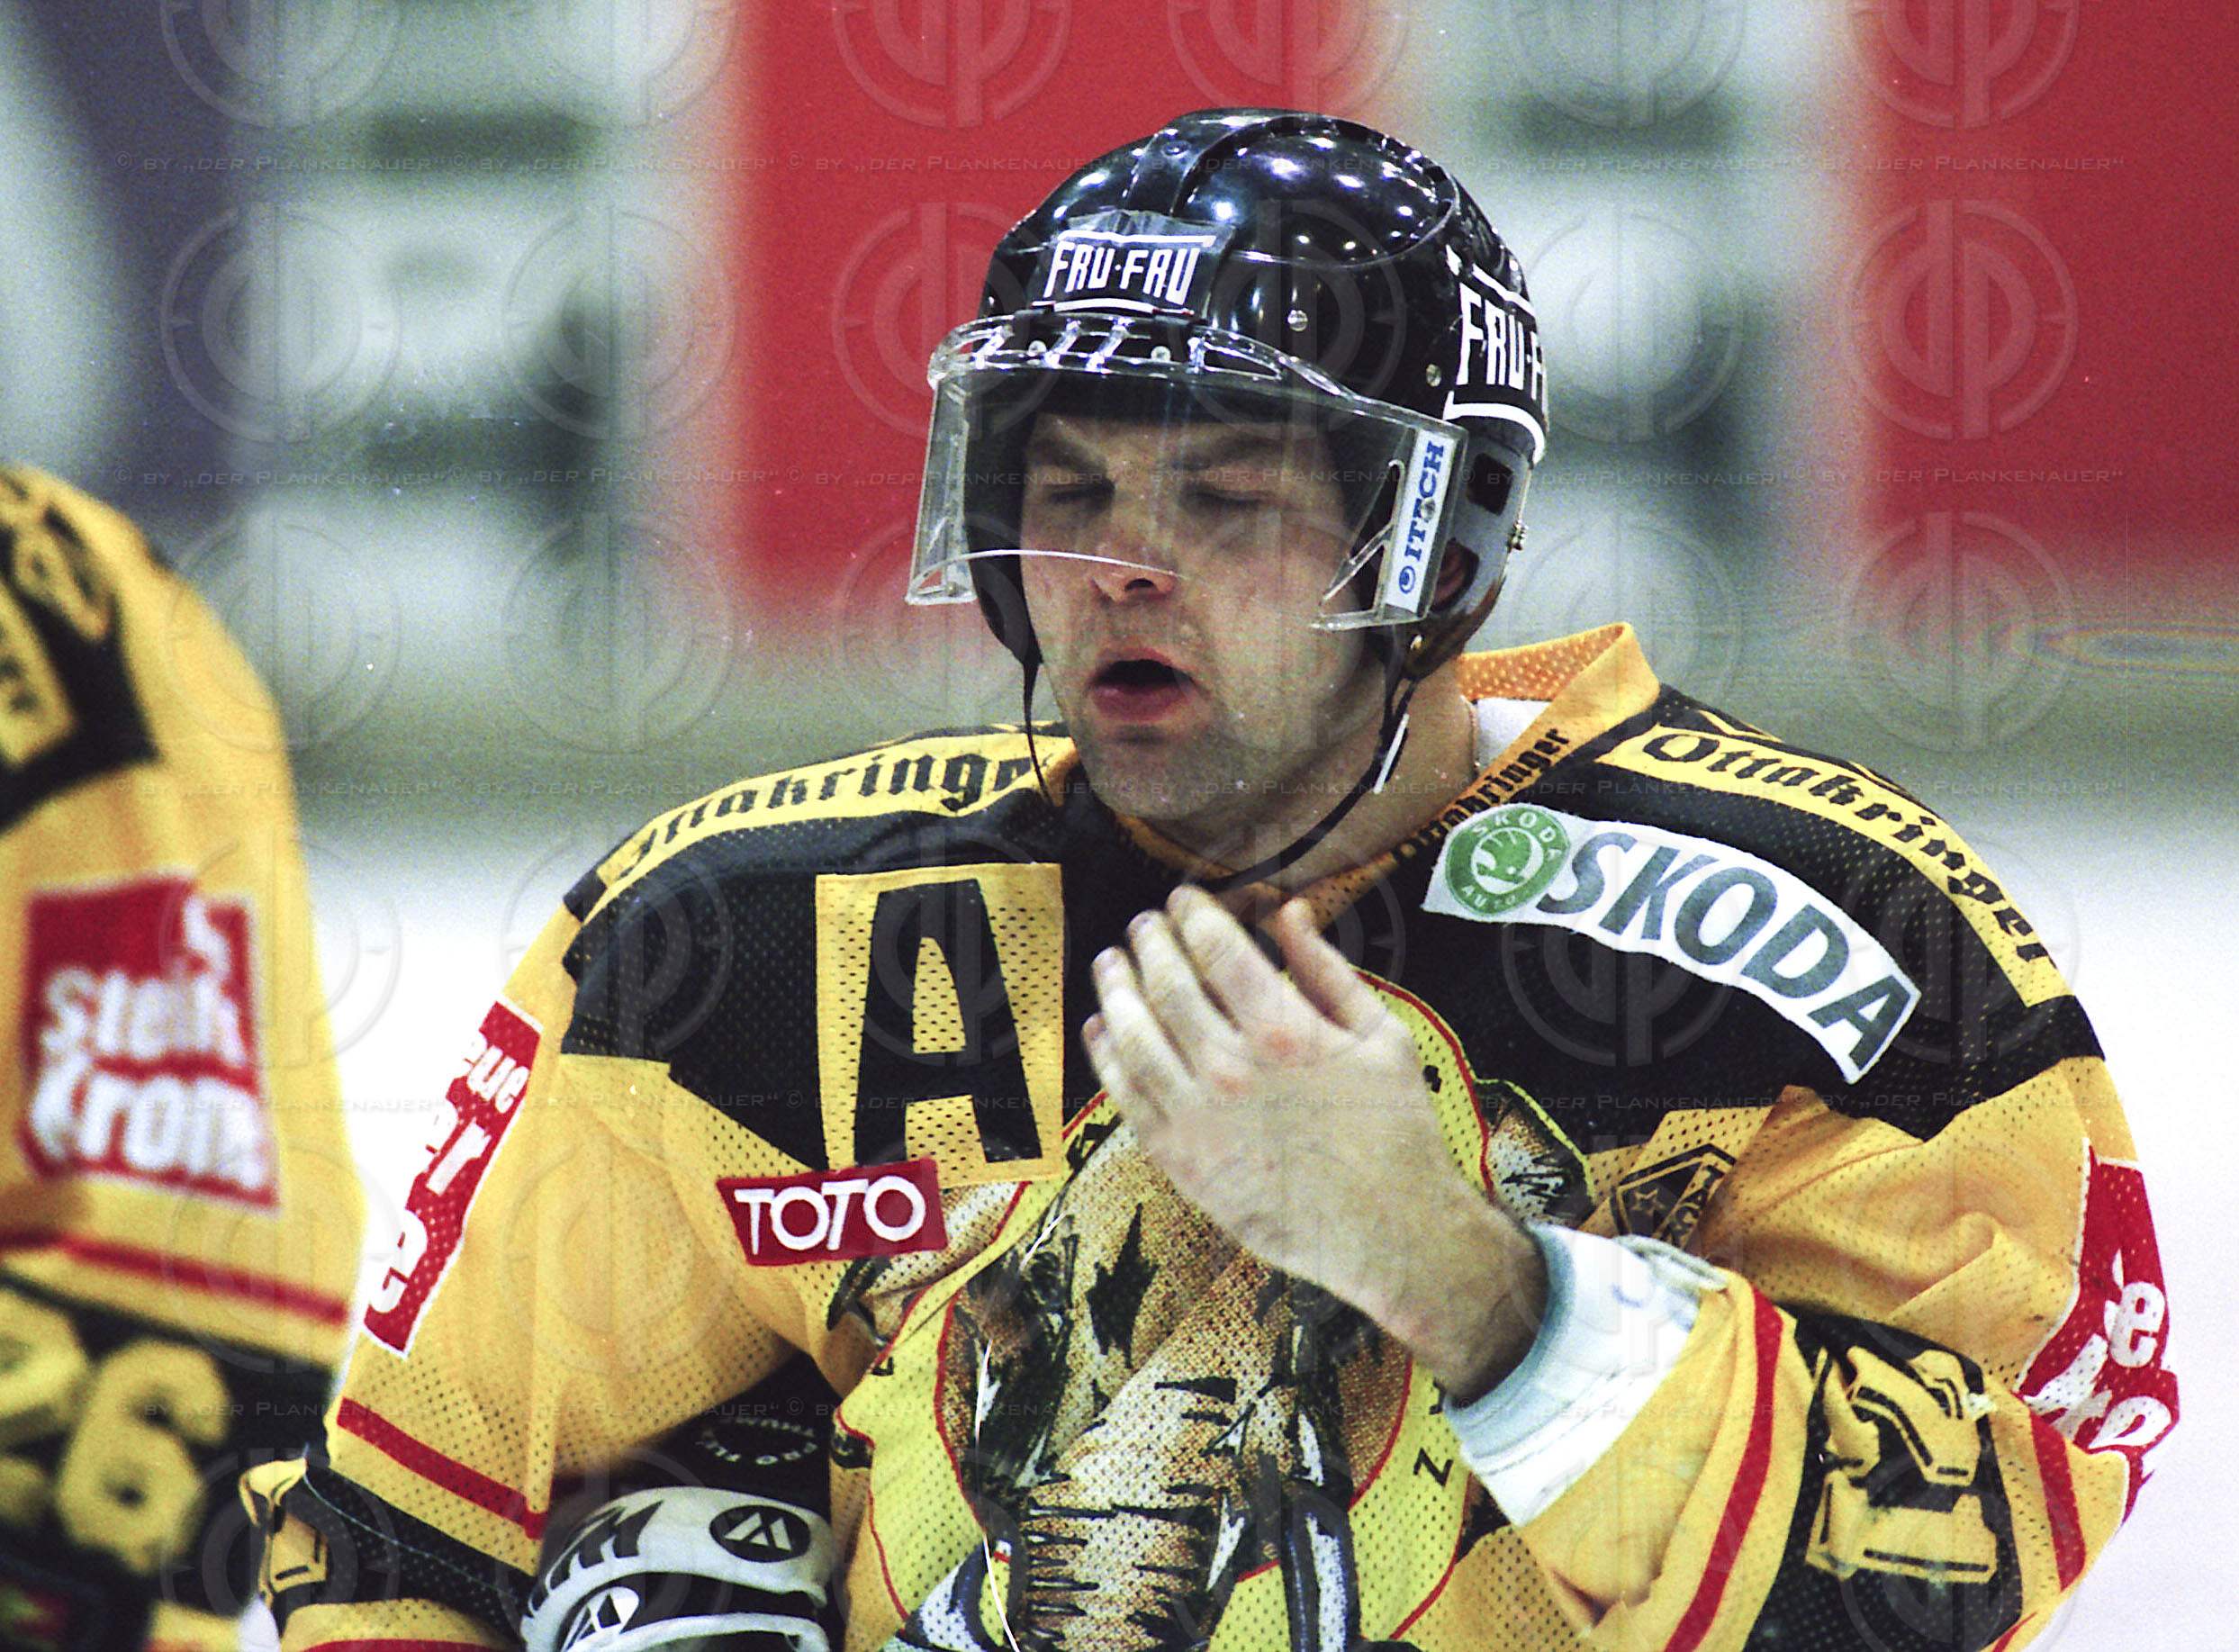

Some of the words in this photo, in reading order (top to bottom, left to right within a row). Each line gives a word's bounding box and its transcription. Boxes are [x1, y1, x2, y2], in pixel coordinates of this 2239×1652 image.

[852, 879, 1043, 1175] A
[1534, 831, 1918, 1071] SKODA
[735, 1174, 926, 1255] TOTO
